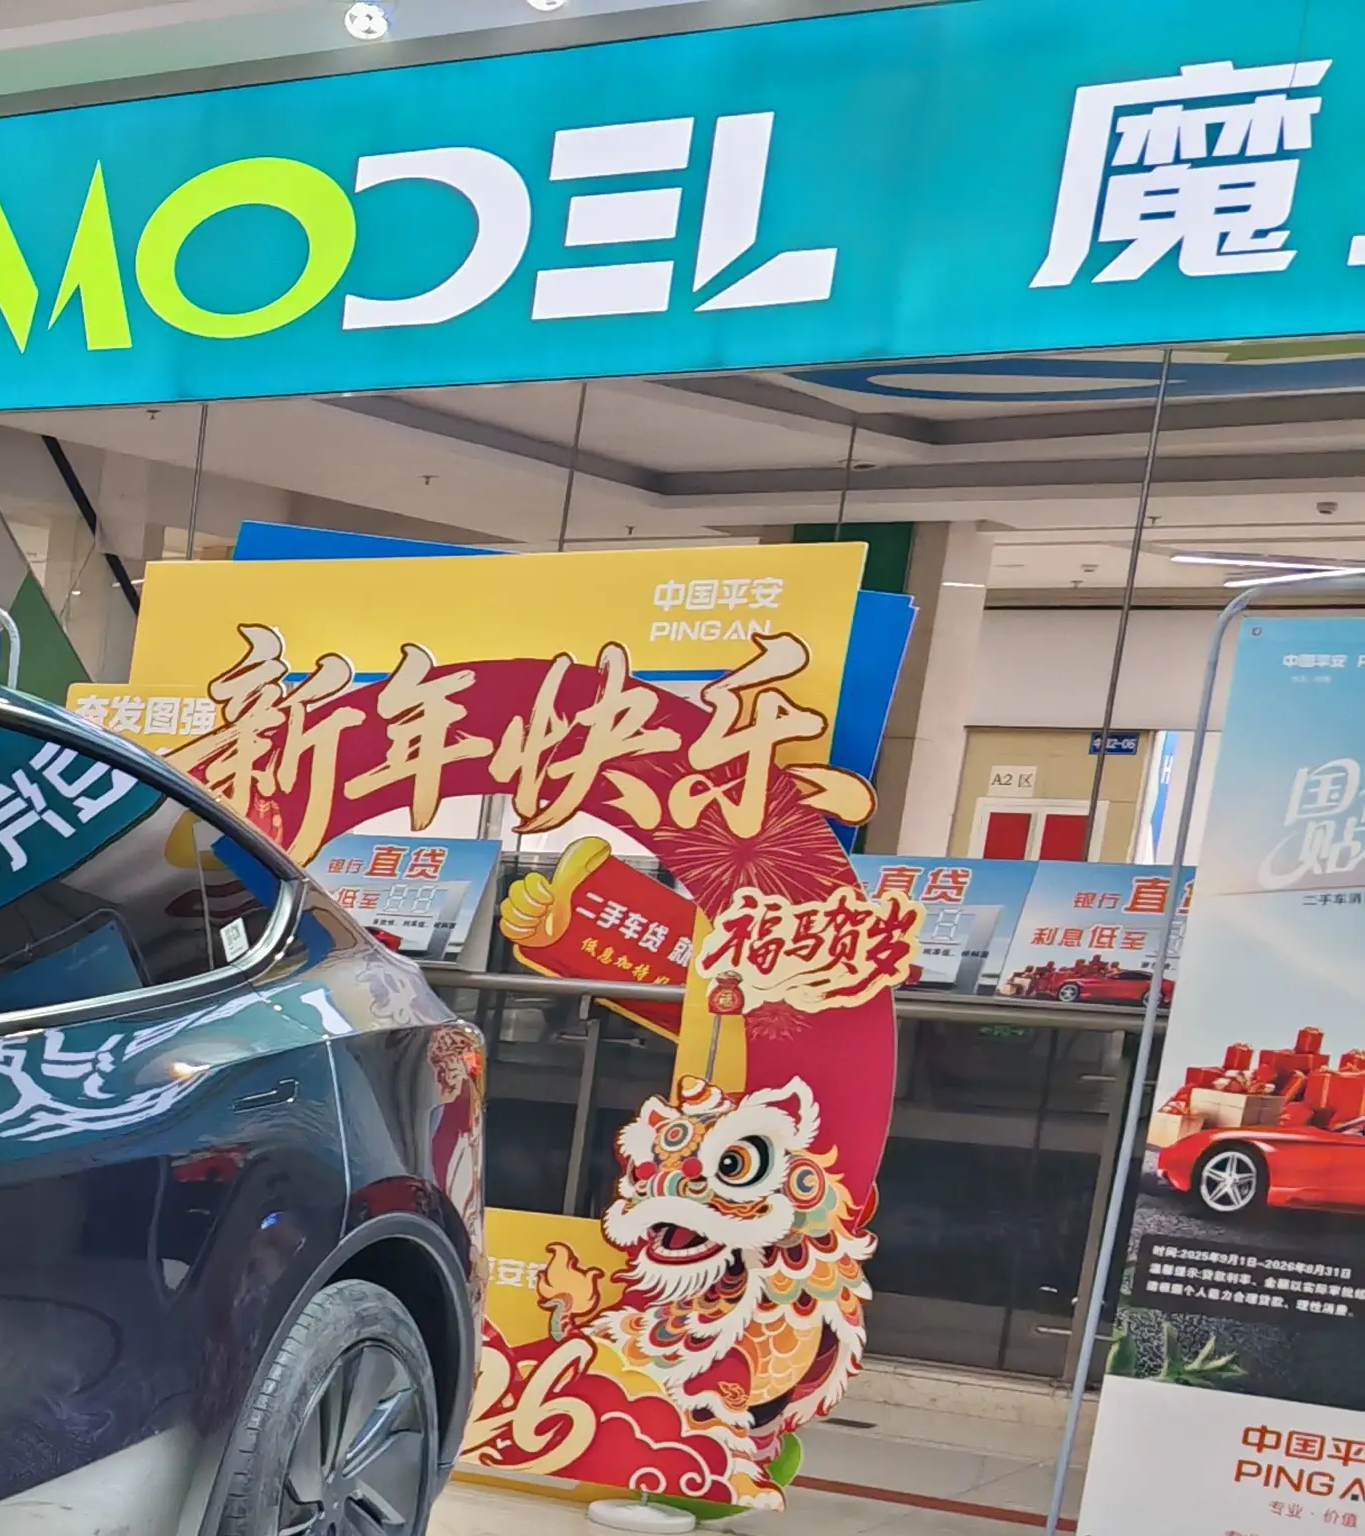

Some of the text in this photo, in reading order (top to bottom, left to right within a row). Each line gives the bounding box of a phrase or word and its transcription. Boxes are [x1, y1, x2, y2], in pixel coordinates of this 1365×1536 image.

[1028, 57, 1365, 286] 魔
[653, 577, 784, 612] 中国平安
[75, 694, 216, 735] 奋发图强
[164, 623, 878, 870] 新年快乐
[991, 773, 1013, 787] A2
[365, 845, 449, 881] 直贷
[871, 865, 972, 904] 直贷
[1072, 891, 1122, 911] 银行
[575, 890, 670, 953] 二手车贷
[1031, 923, 1149, 951] 利息低至
